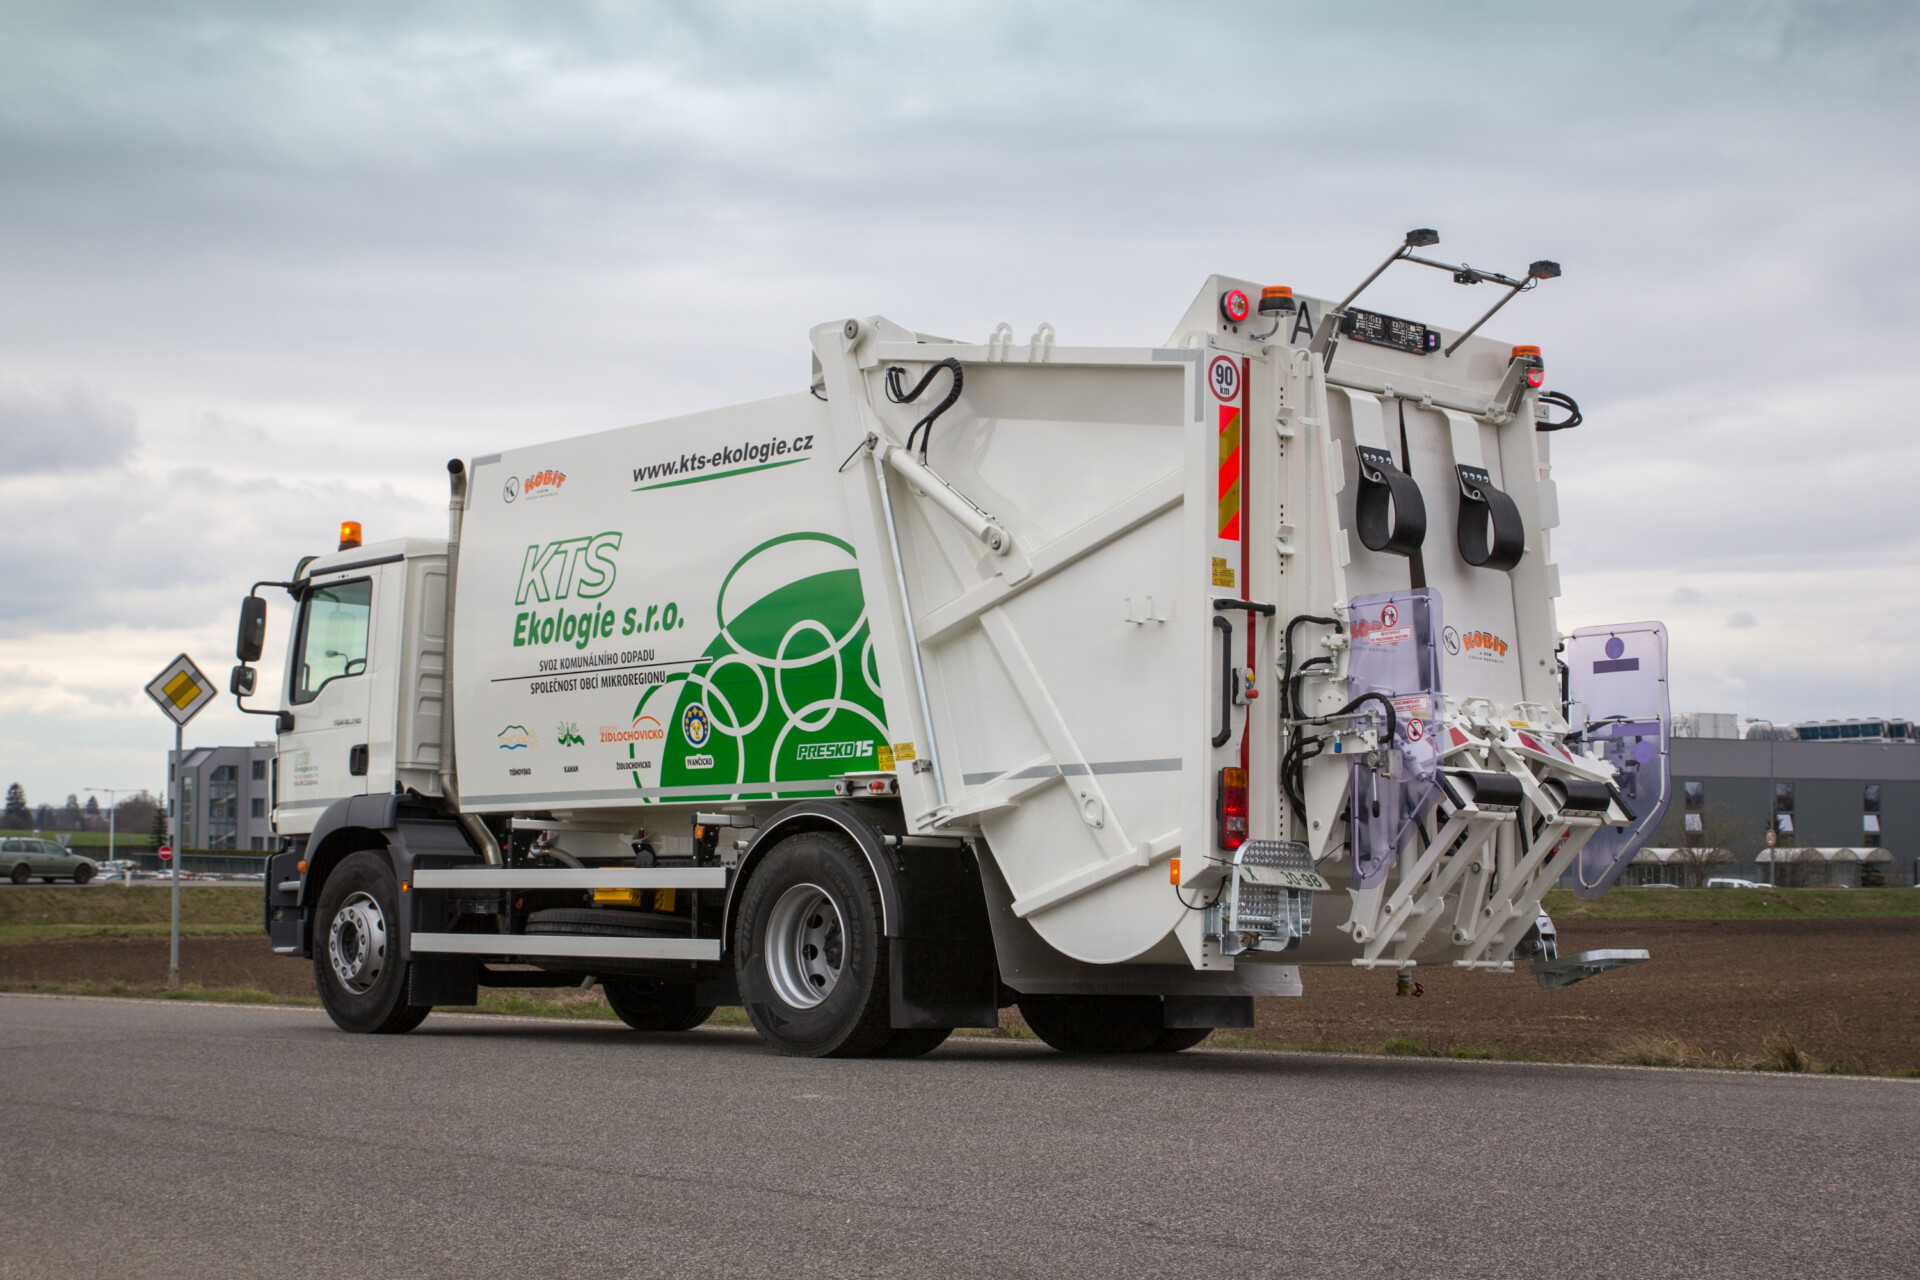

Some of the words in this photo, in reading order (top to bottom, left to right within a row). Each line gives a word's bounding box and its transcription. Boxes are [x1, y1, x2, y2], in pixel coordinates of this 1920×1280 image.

[1290, 301, 1314, 344] A
[1215, 364, 1233, 387] 90
[1219, 385, 1230, 396] km
[633, 435, 814, 482] www.kts-ekologie.cz
[524, 470, 567, 495] KOBIT
[515, 531, 623, 606] KTS
[513, 601, 616, 650] Ekologie
[622, 602, 684, 636] s.r.o.
[1462, 630, 1508, 657] KOBIT
[539, 658, 558, 672] SVOZ
[560, 650, 619, 670] KOMUNÁLNÍHO
[621, 649, 655, 664] ODPADU
[530, 677, 578, 695] SPOLEČNOST
[580, 673, 599, 690] OBCÍ
[600, 670, 666, 689] MIKROREGIONU
[616, 760, 652, 771] ŽIDLOCHOVICKO
[687, 756, 713, 767] IVANČICKO
[1280, 871, 1323, 888] 30-98
